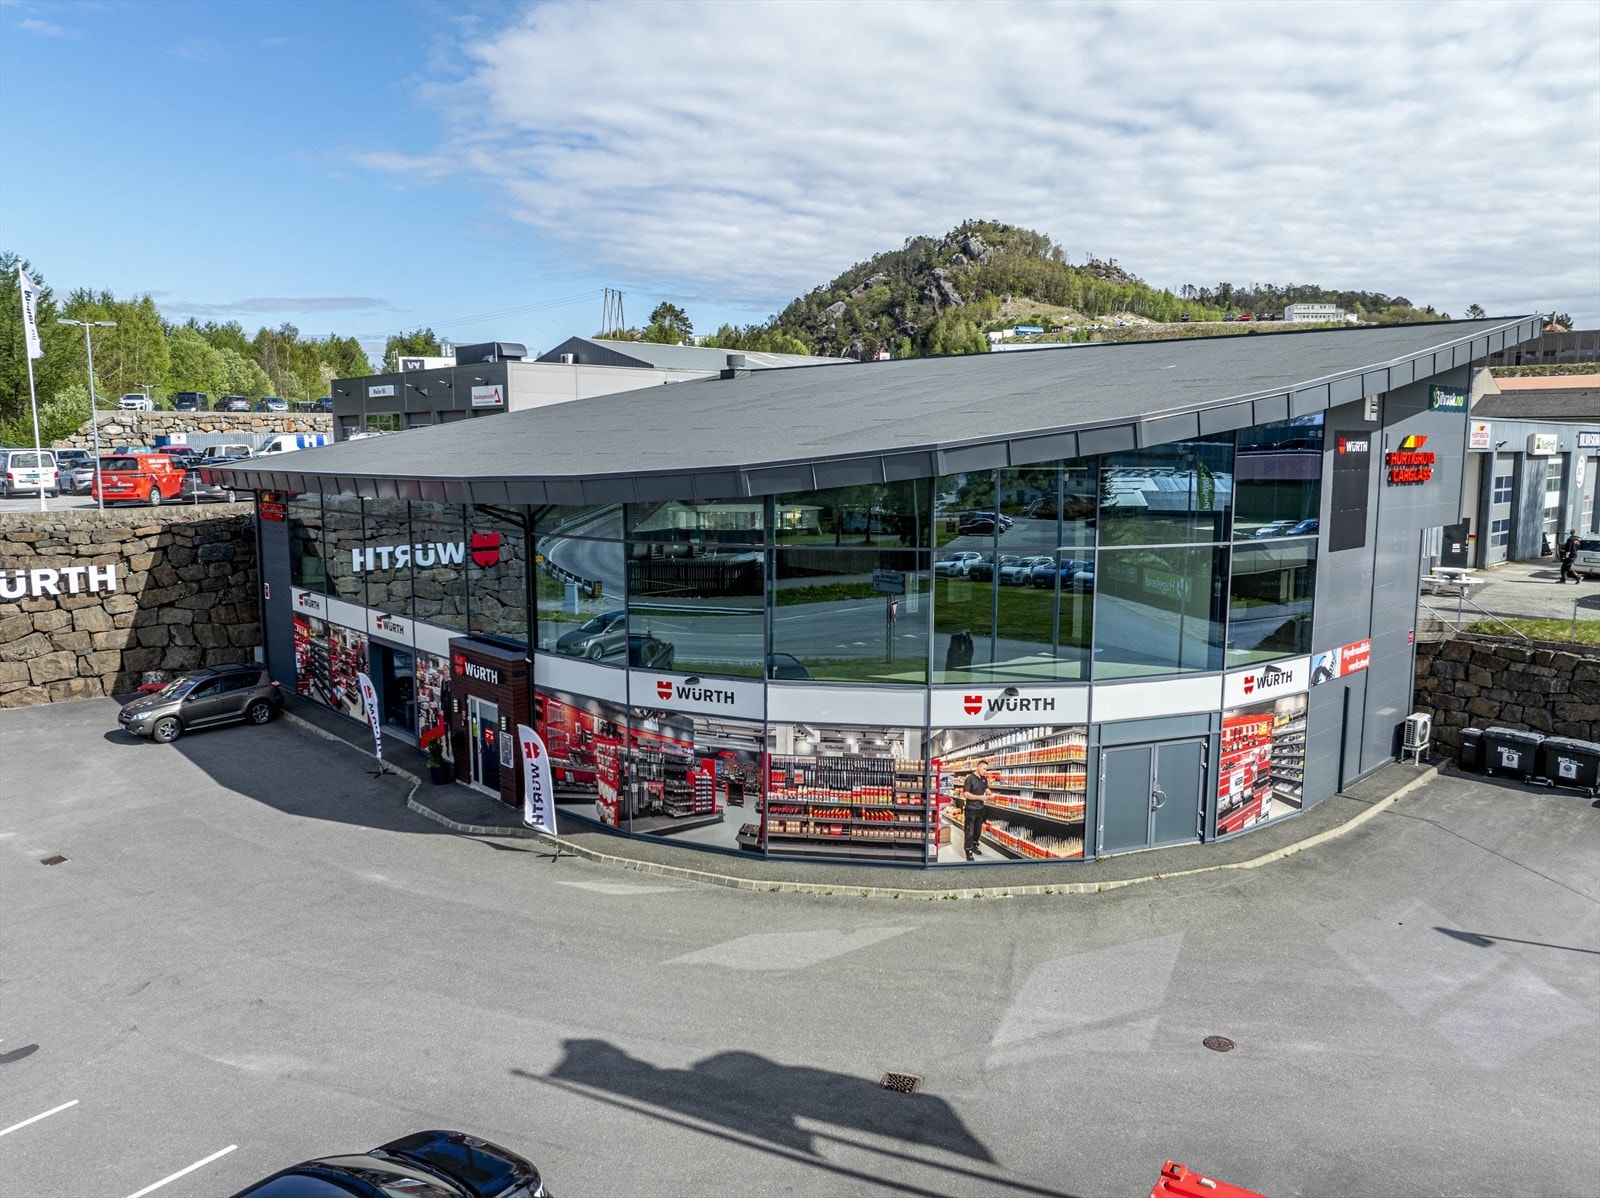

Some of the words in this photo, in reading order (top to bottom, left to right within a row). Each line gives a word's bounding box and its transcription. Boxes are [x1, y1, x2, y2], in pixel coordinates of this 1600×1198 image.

[1346, 440, 1368, 452] WÜRTH
[1390, 452, 1436, 465] HURTIGRUTA
[1392, 468, 1432, 482] CARGLASS
[383, 620, 404, 635] WÜRTH
[464, 661, 498, 685] WÜRTH
[1257, 670, 1293, 690] WÜRTH
[676, 686, 735, 705] WÜRTH
[987, 697, 1055, 712] WÜRTH
